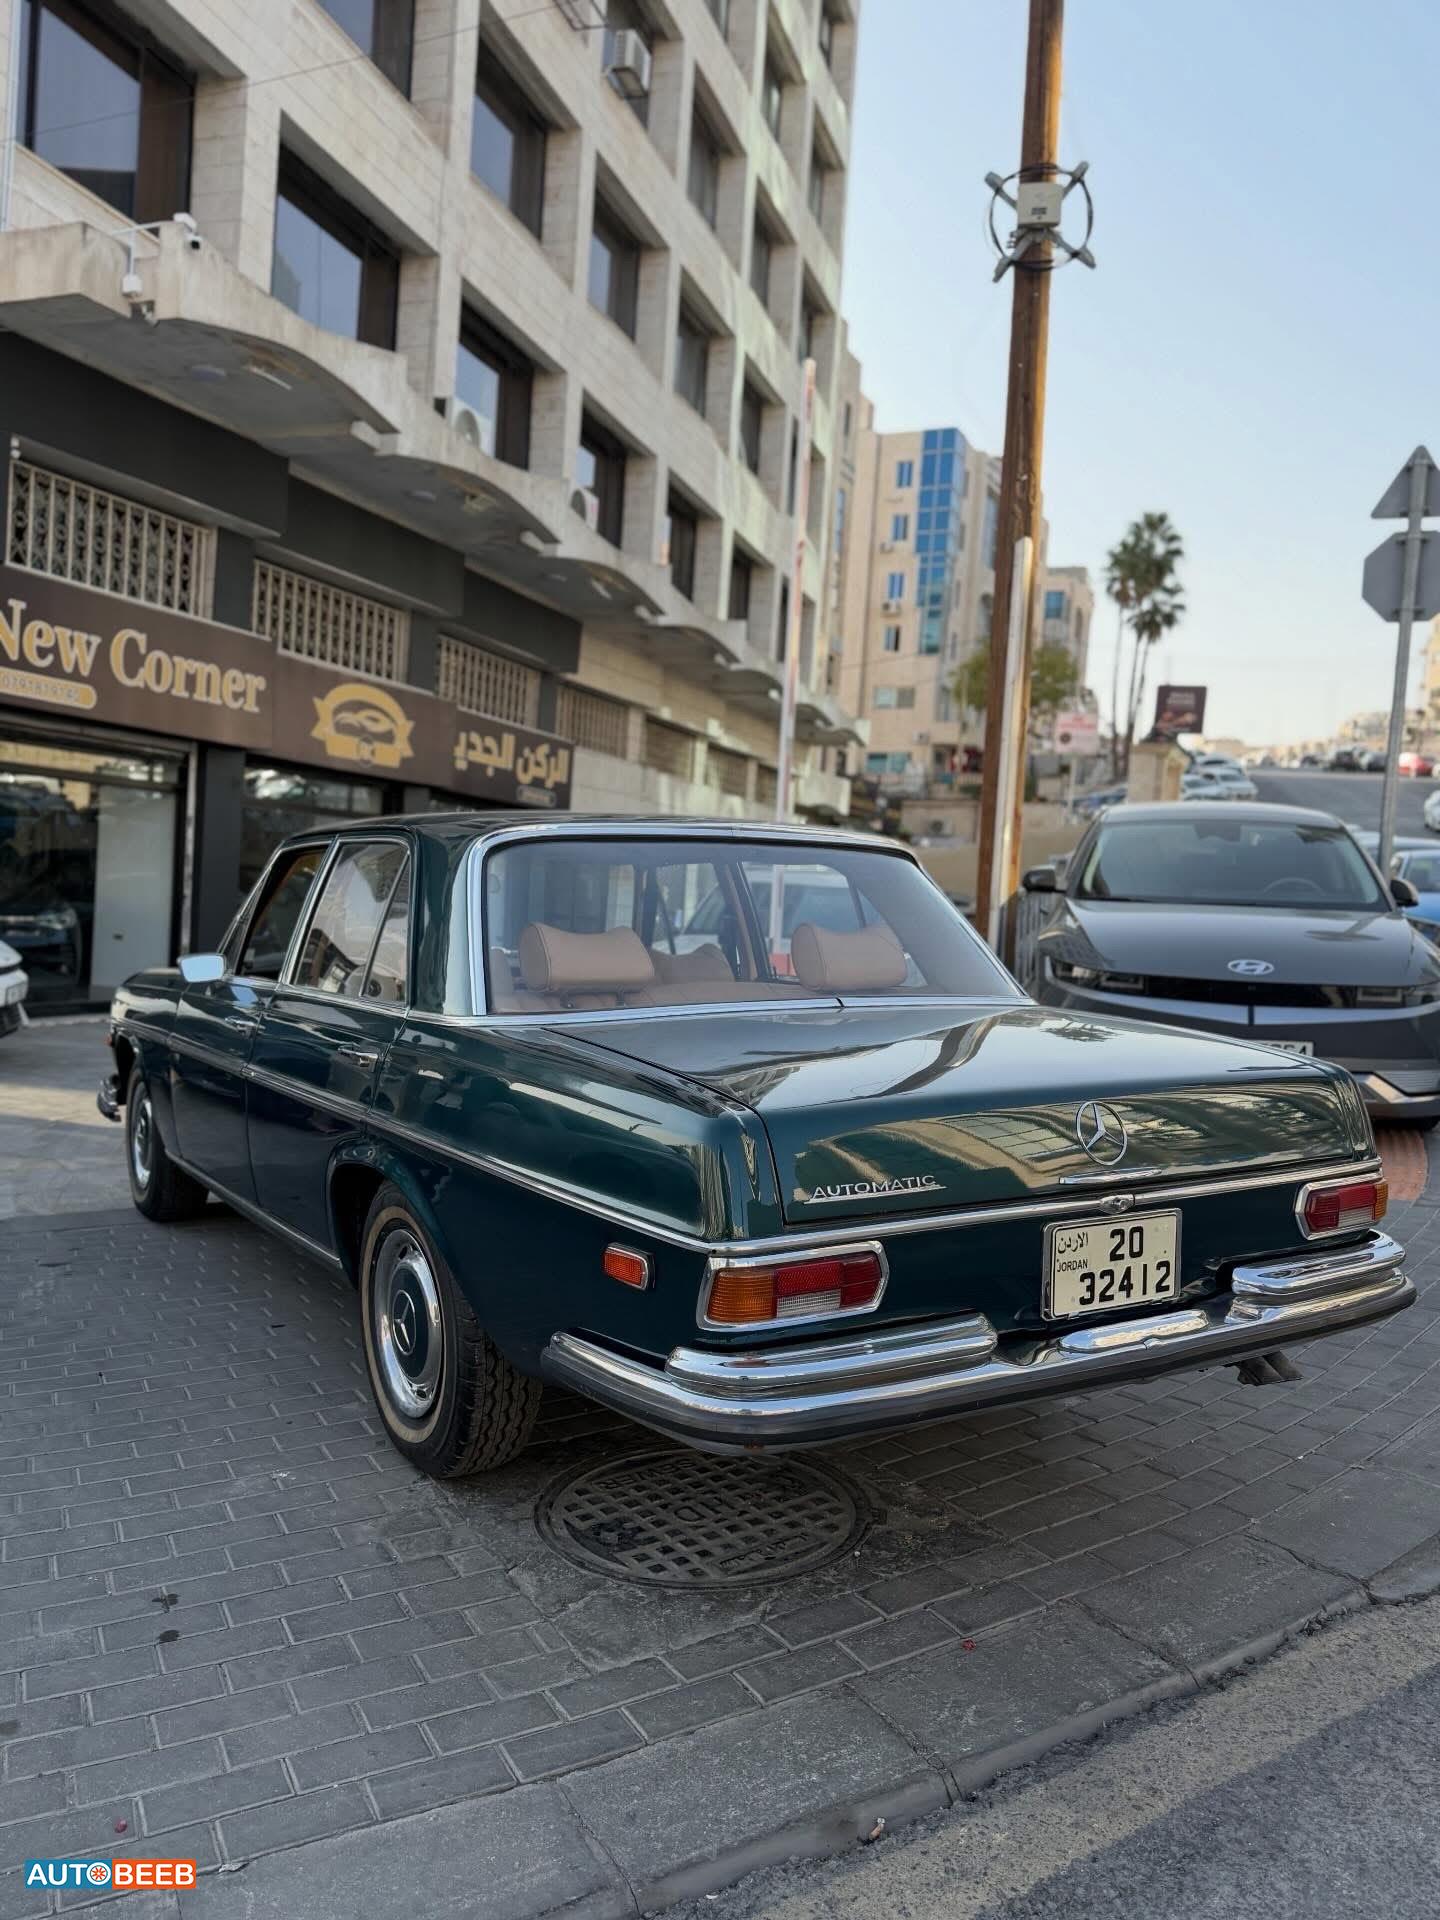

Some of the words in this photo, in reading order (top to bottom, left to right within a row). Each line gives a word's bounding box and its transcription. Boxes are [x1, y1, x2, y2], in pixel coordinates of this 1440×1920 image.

[0, 599, 101, 676] New
[110, 628, 266, 712] Corner
[516, 742, 569, 788] الركن
[811, 1175, 937, 1200] AUTOMATIC
[1109, 1225, 1144, 1262] 20
[1056, 1258, 1089, 1272] JORDAN
[1078, 1259, 1171, 1306] 32412
